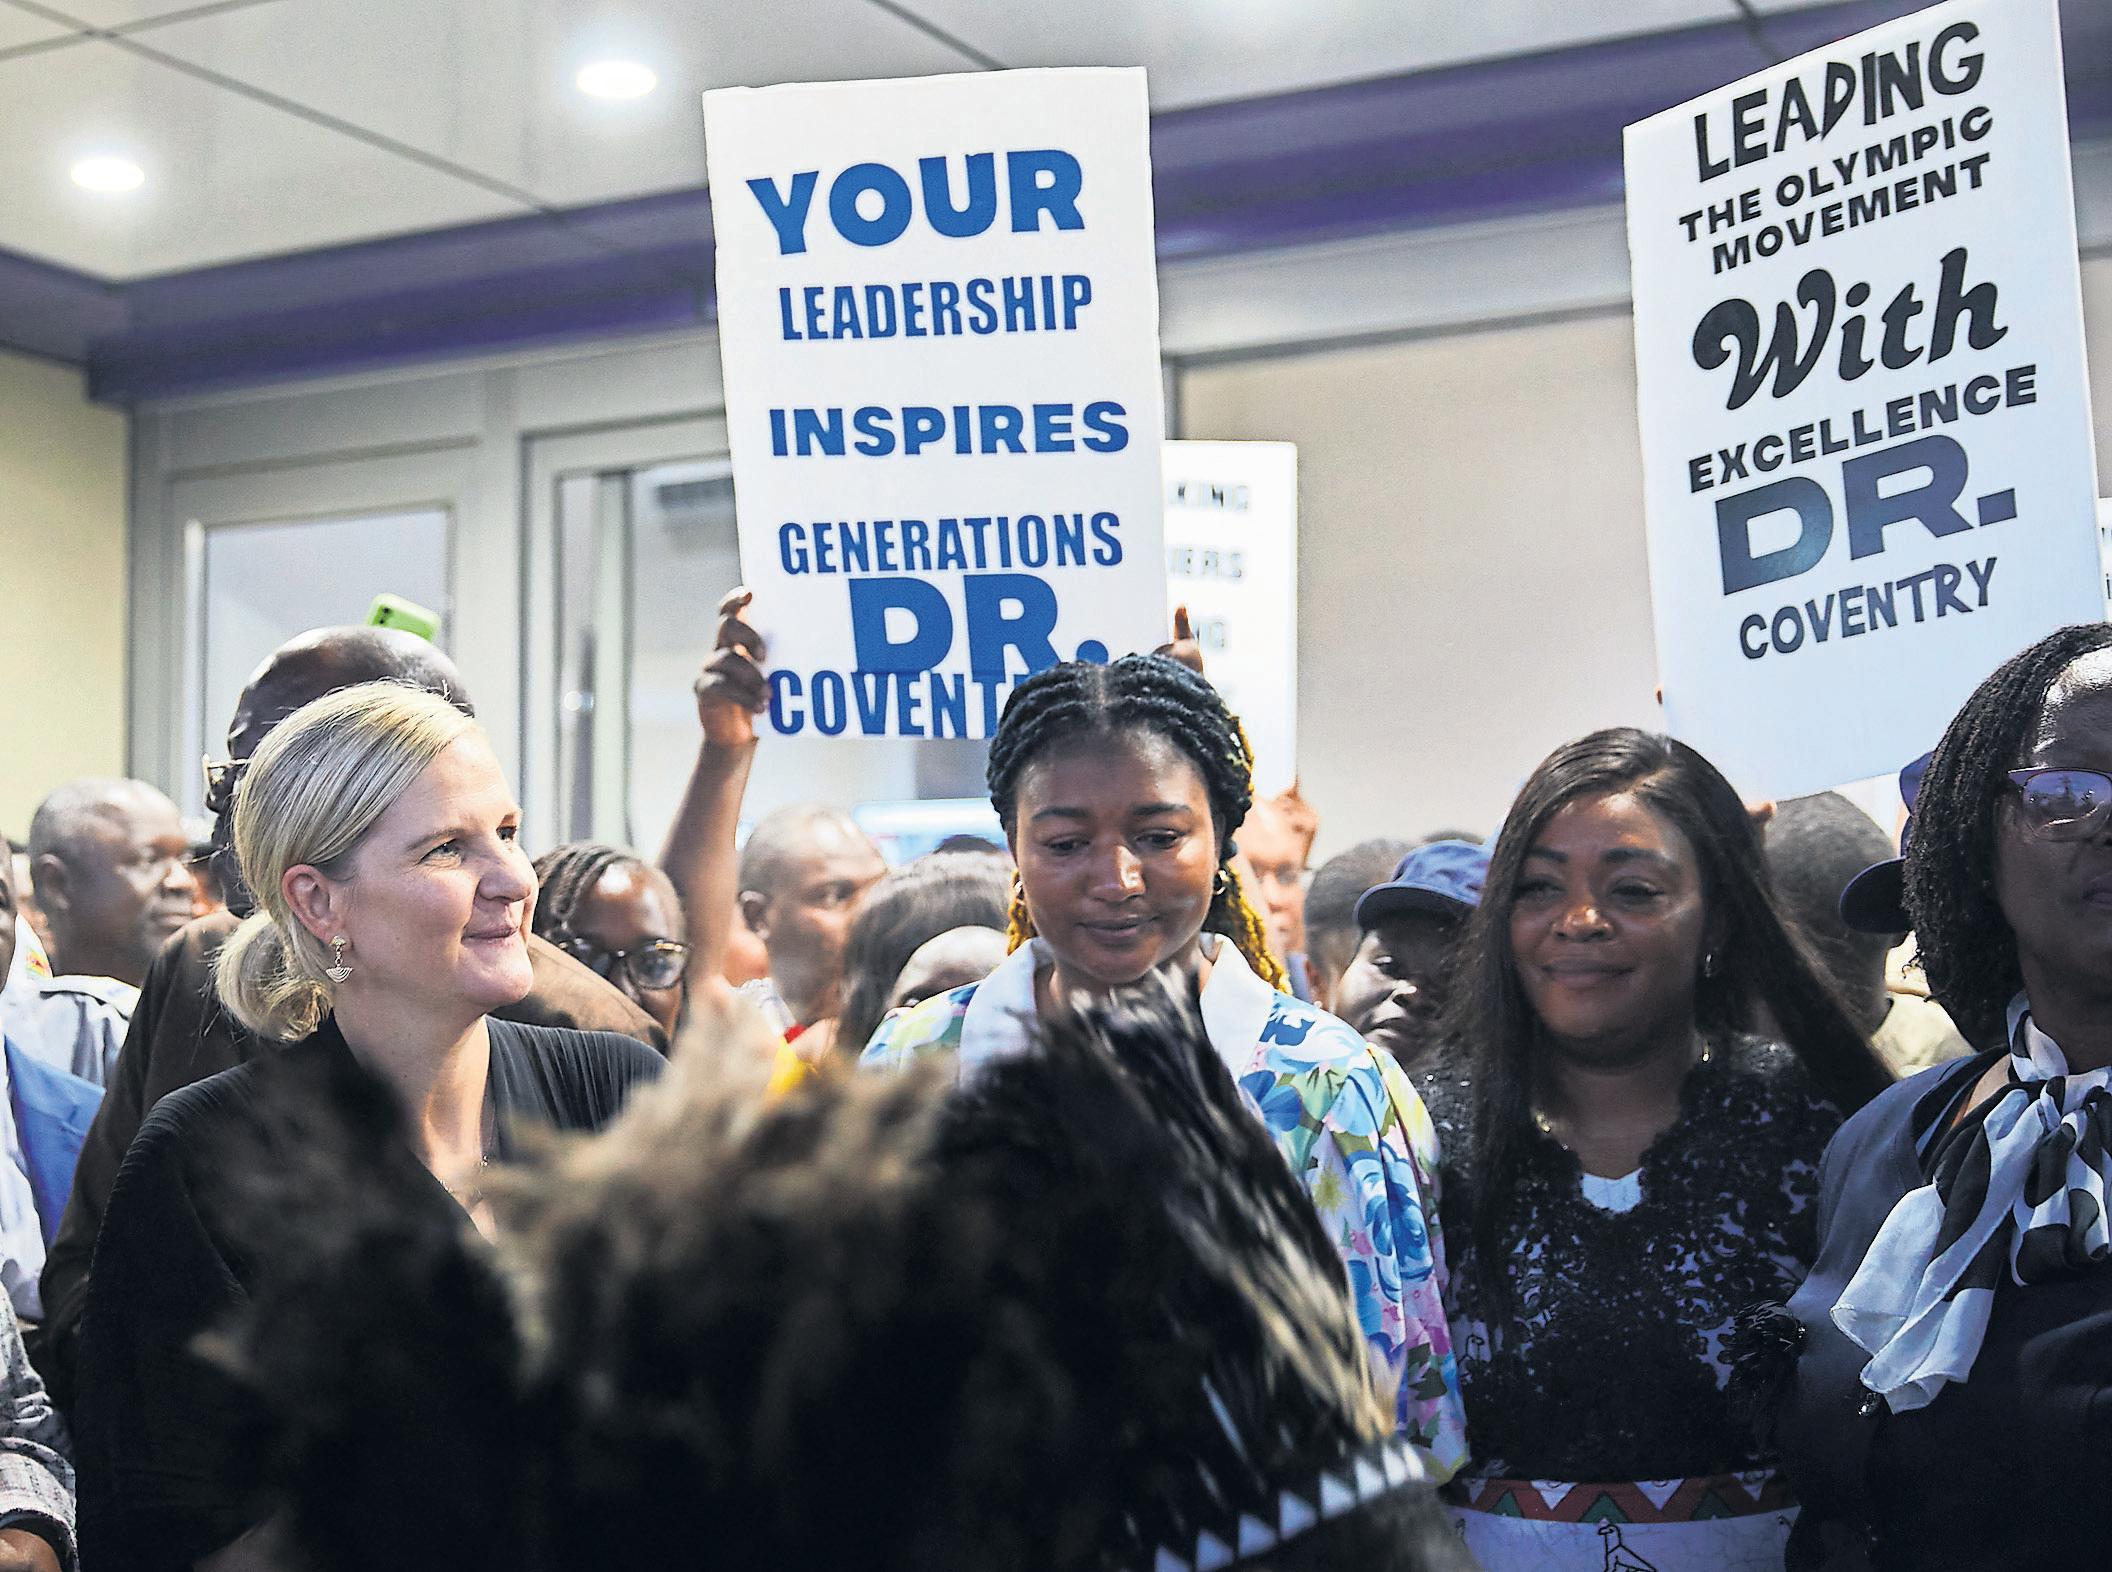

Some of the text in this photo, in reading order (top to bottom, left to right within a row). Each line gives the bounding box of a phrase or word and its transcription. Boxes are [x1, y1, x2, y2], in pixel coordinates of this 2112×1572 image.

[1694, 21, 1985, 183] LEADING
[745, 149, 1086, 256] YOUR
[1678, 104, 1994, 243] THE OLYMPIC
[1712, 151, 1992, 275] MOVEMENT
[778, 274, 1093, 341] LEADERSHIP
[1691, 246, 2009, 411] With
[769, 401, 1130, 457] INSPIRES
[1688, 363, 2038, 494] EXCELLENCE
[778, 511, 1124, 575] GENERATIONS
[1714, 434, 2019, 597] DR.
[848, 572, 1110, 683] DR.
[1739, 556, 1998, 660] COVENTRY
[768, 669, 1028, 740] COVENT
